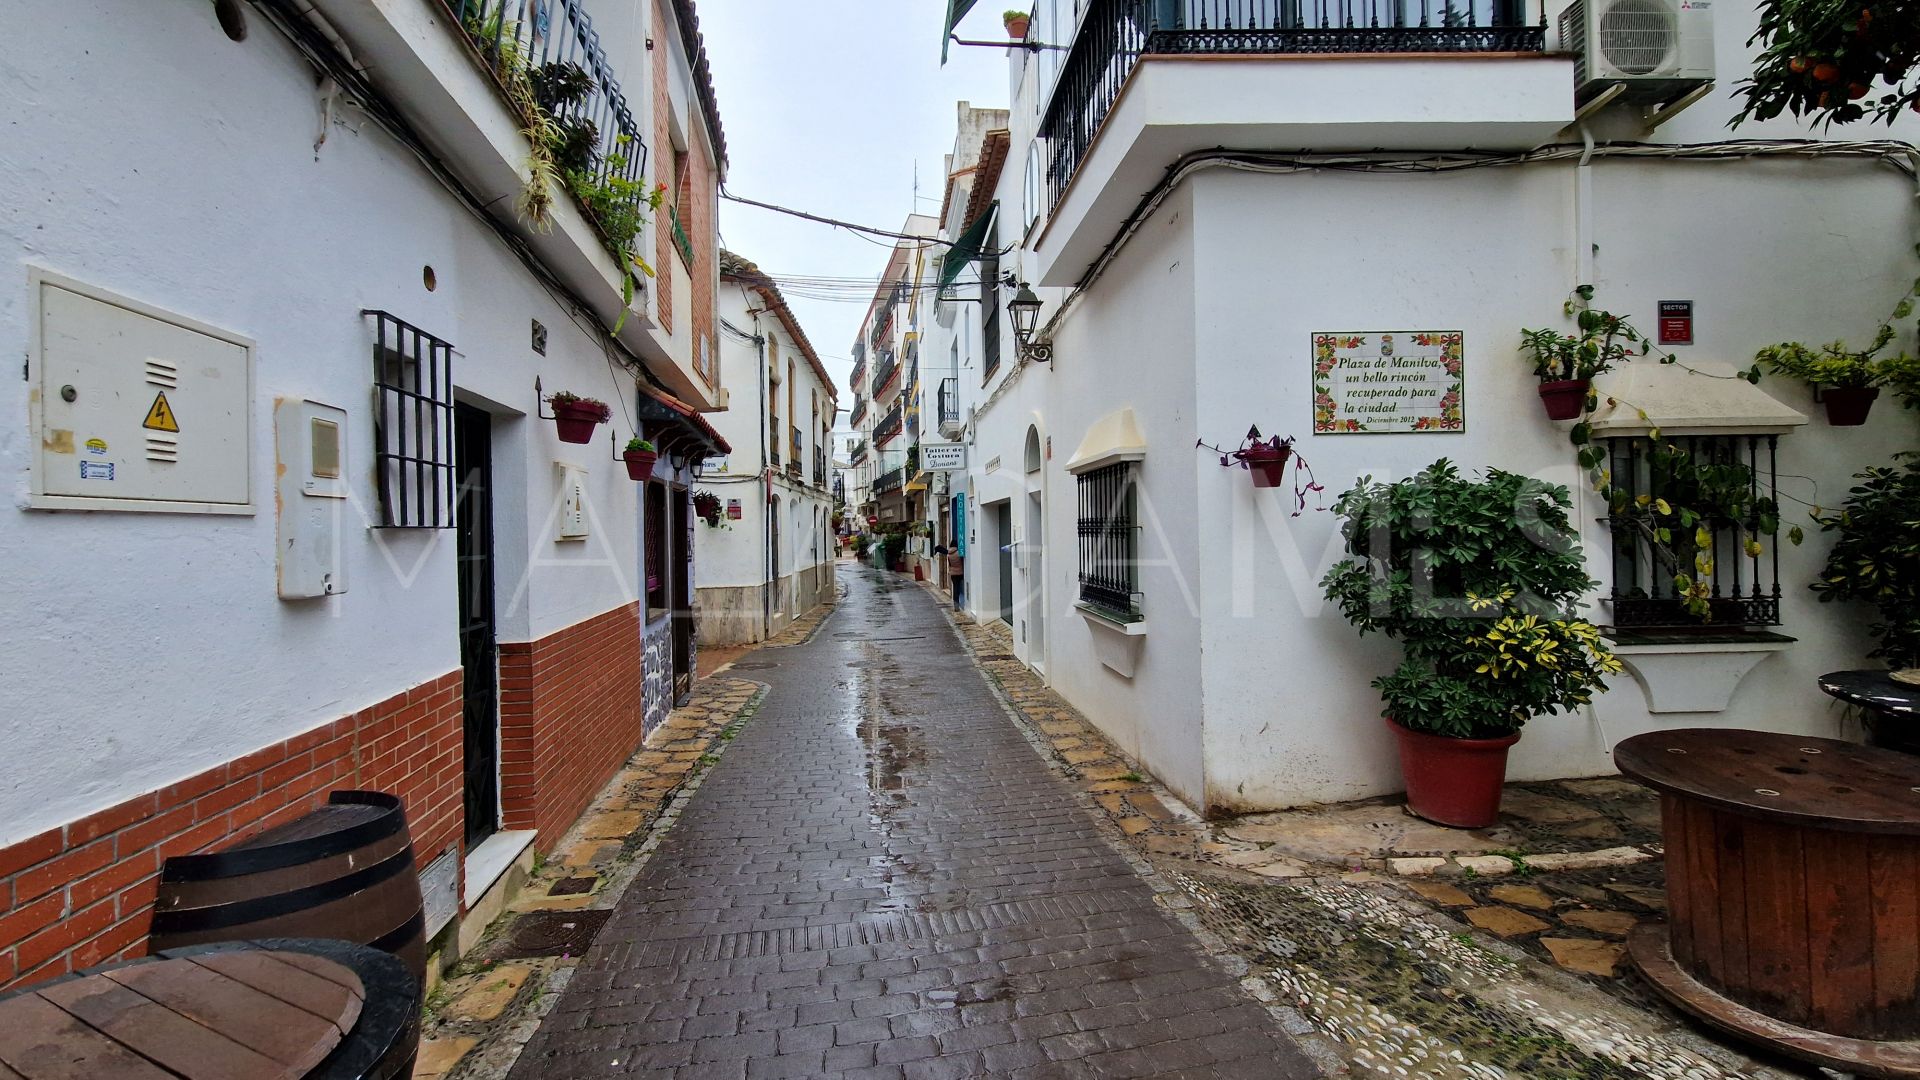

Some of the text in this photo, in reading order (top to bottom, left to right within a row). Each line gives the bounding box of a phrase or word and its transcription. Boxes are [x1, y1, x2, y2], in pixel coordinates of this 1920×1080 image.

[1338, 357, 1442, 369] Plaza de Manilva,
[1363, 372, 1388, 382] bello
[1390, 372, 1426, 382] rincón
[1346, 386, 1436, 399] recuperado para
[1344, 402, 1355, 413] la
